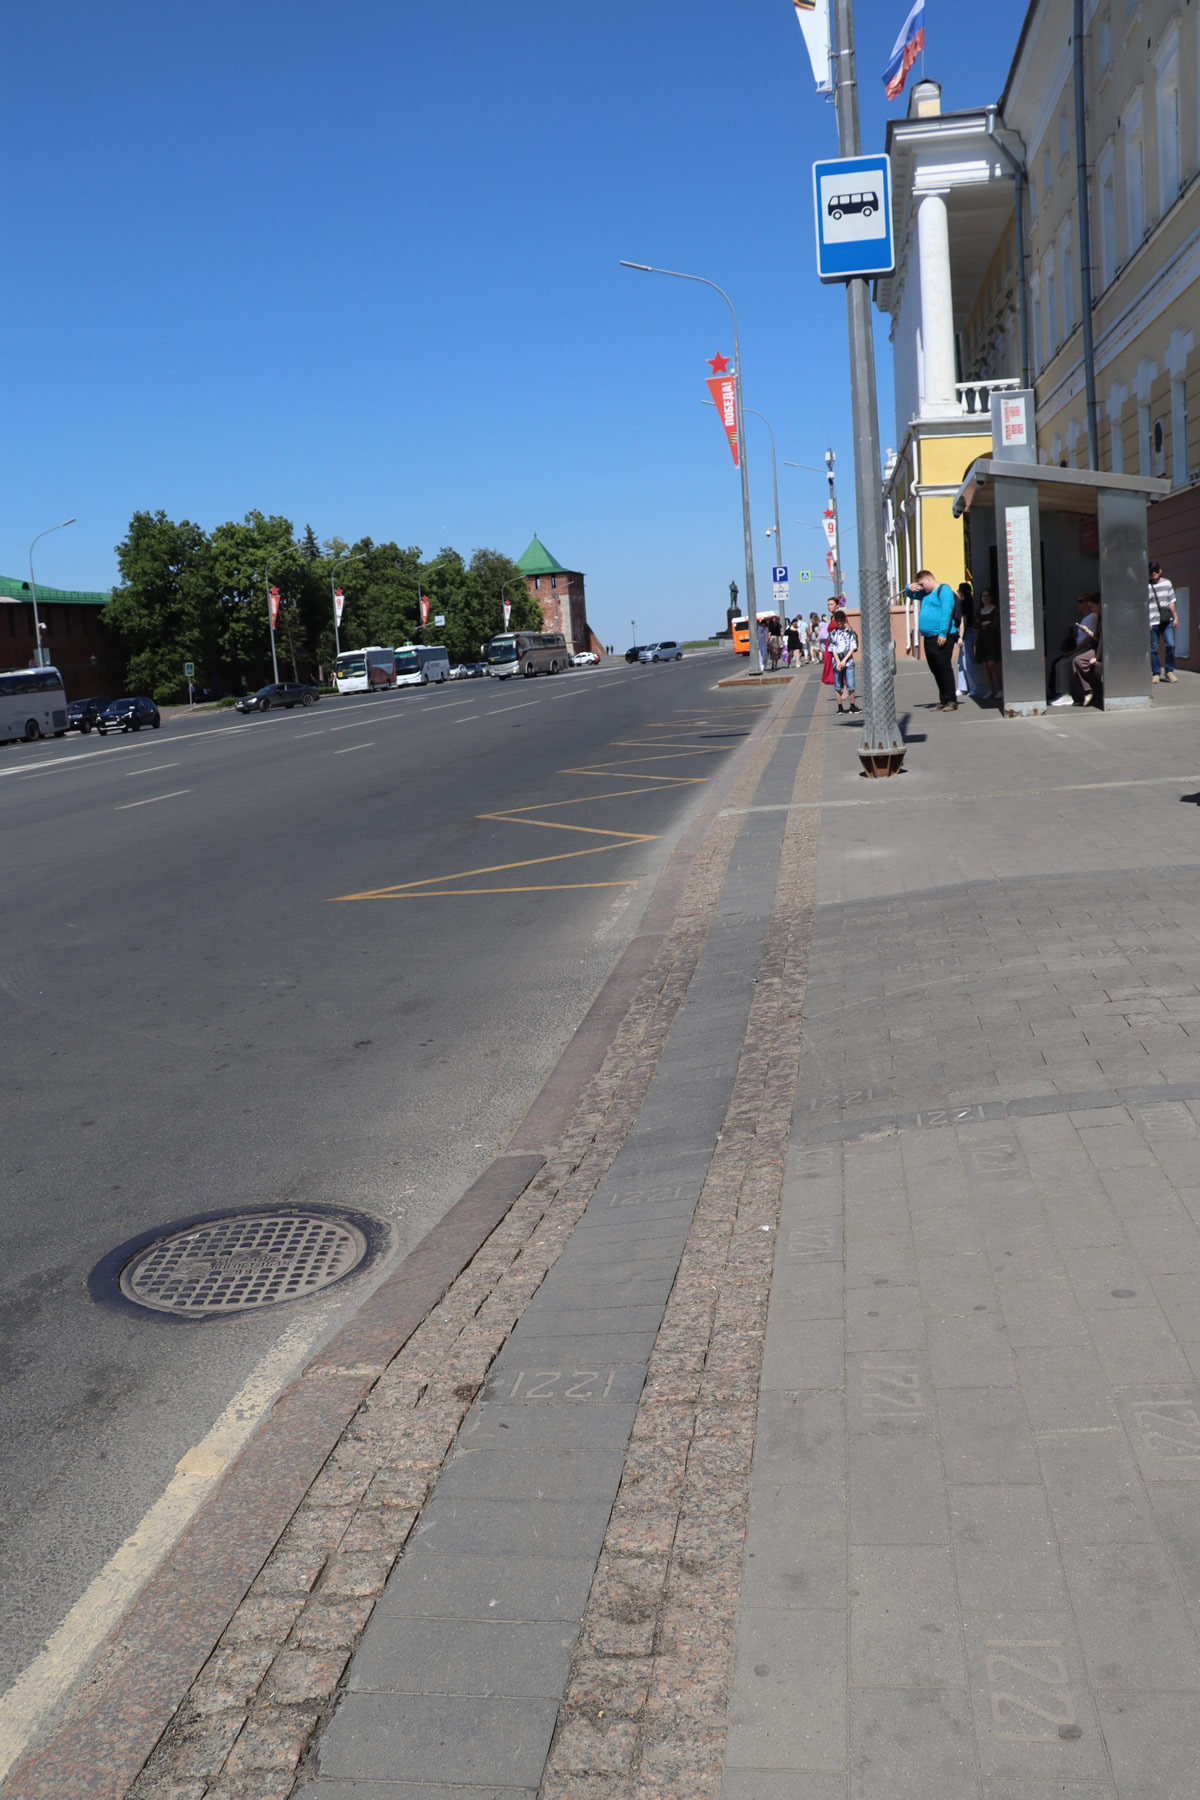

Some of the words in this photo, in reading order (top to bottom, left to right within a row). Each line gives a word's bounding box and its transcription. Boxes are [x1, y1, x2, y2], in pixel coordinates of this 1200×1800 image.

[721, 381, 735, 427] ПОБЕДА!
[827, 522, 834, 534] 9
[776, 568, 786, 581] P
[916, 1104, 985, 1127] 1221
[508, 1370, 616, 1398] 1221
